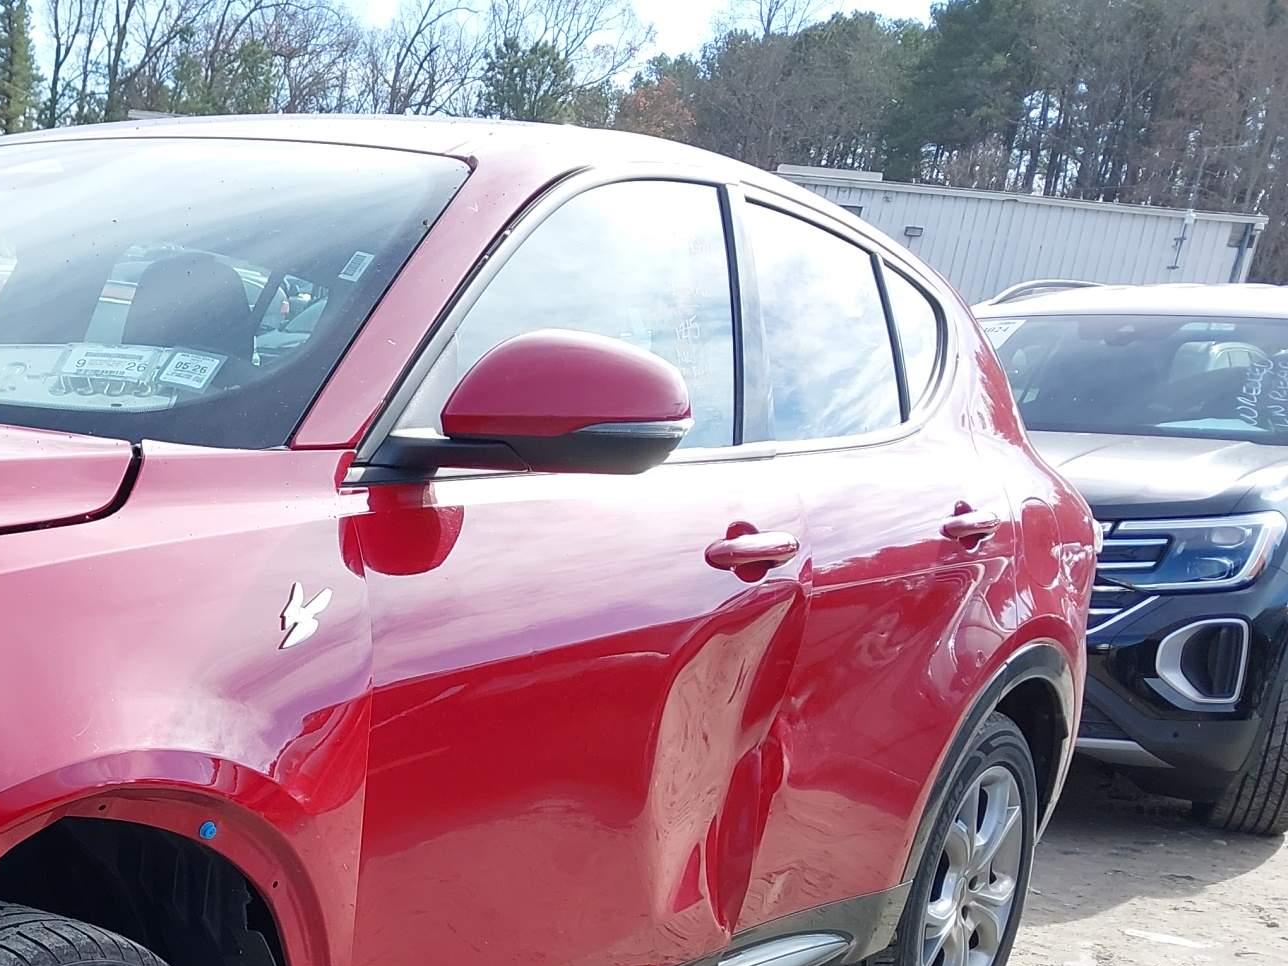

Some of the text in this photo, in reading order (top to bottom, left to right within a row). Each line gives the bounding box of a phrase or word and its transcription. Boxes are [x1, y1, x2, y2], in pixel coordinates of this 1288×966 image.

[75, 358, 149, 372] 9 26
[174, 360, 209, 374] 05 26
